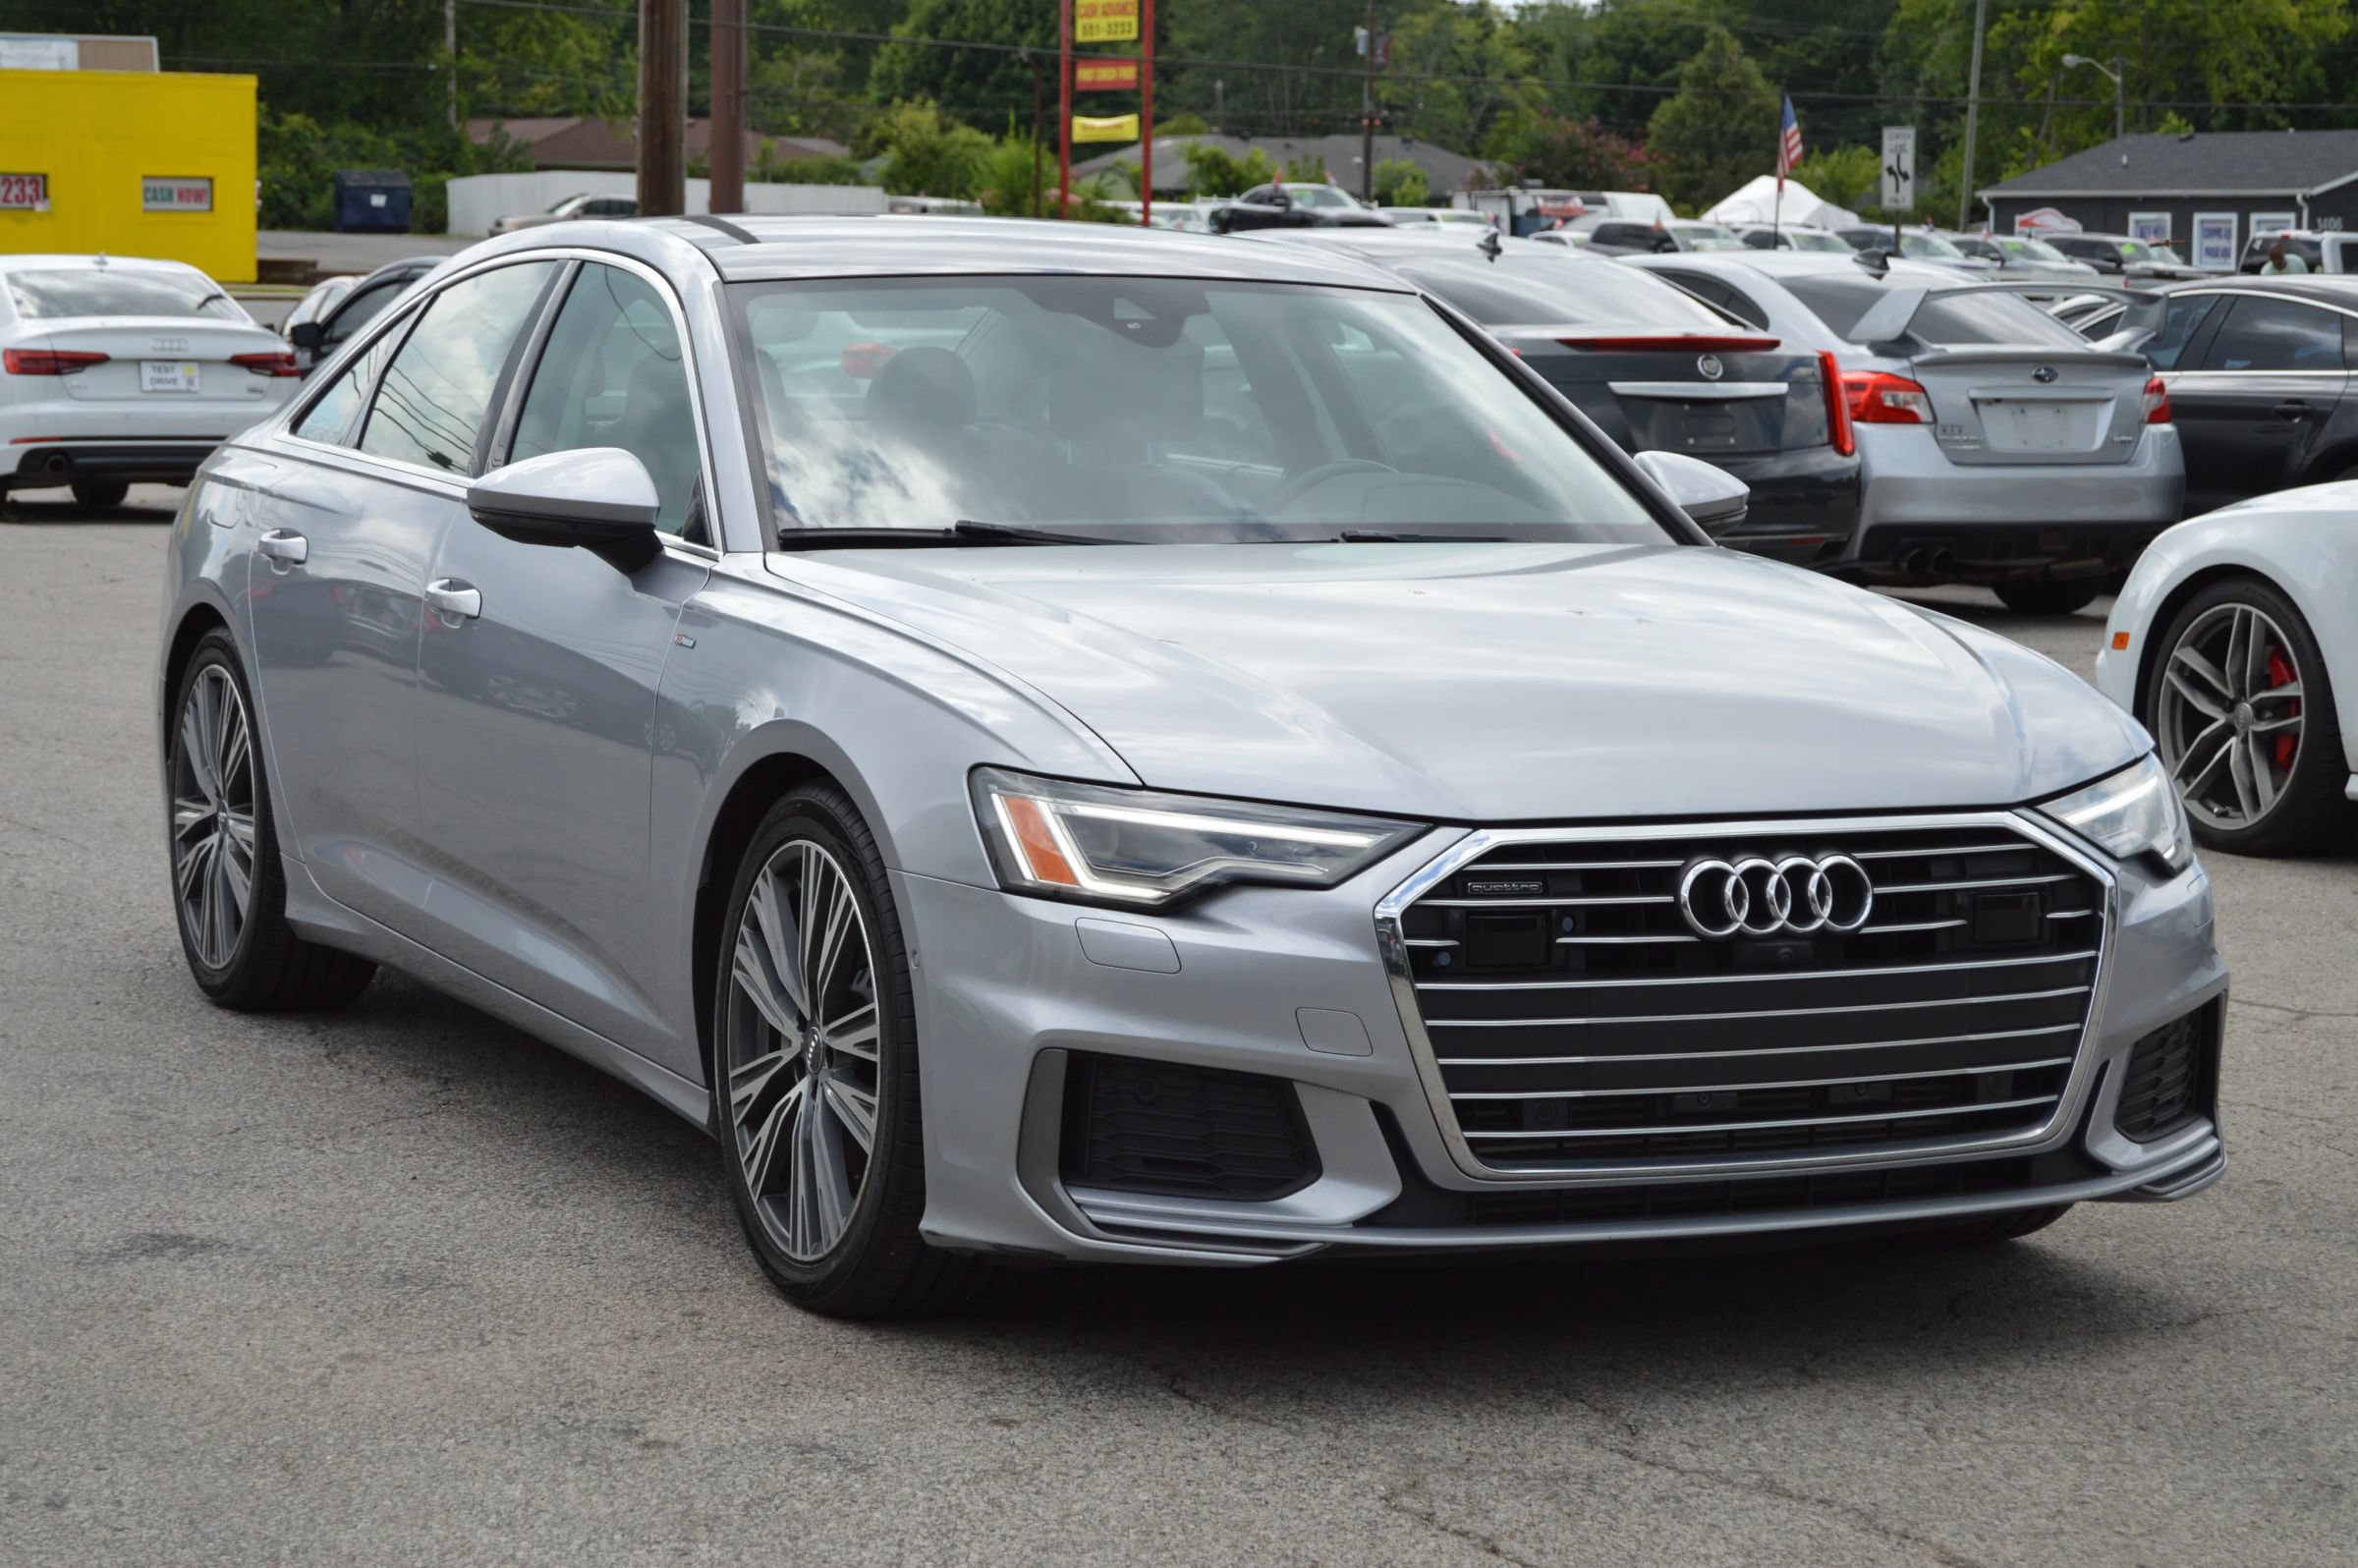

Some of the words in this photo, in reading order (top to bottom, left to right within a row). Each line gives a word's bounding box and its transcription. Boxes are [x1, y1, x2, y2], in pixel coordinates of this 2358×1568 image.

[143, 187, 174, 203] CASH
[151, 364, 176, 374] TEST
[149, 376, 178, 386] DRIVE
[1472, 883, 1540, 893] quattro
